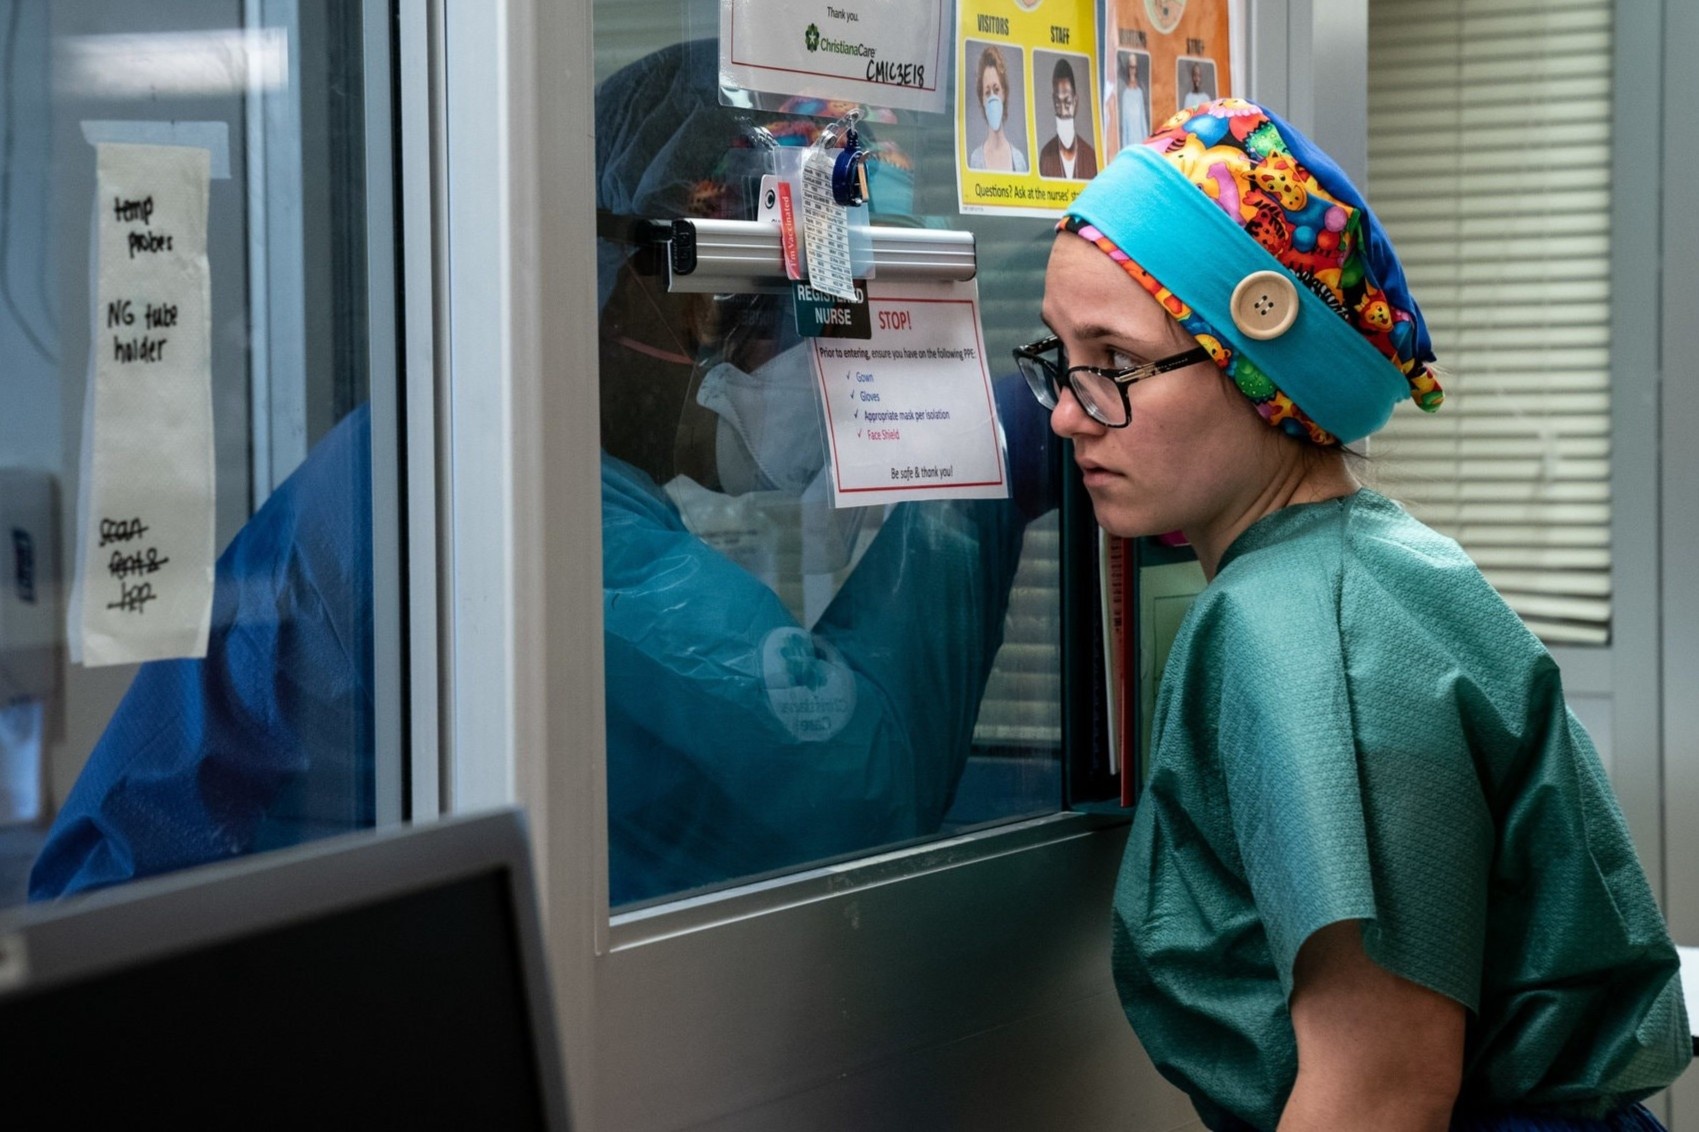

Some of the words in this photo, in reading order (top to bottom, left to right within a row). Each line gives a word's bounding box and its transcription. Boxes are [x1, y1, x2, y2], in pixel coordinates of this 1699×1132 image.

[827, 6, 845, 19] Thank
[847, 11, 859, 22] you.
[977, 13, 1009, 36] VISITORS
[1050, 25, 1070, 45] STAFF
[820, 38, 876, 58] ChristianaCare
[975, 183, 1012, 198] Questions?
[1014, 186, 1026, 199] Ask
[1027, 188, 1034, 199] at
[1035, 188, 1046, 200] the
[113, 196, 154, 225] temp
[781, 196, 795, 249] Vaccinated
[797, 284, 864, 304] REGISD
[107, 300, 135, 329] NG
[144, 302, 178, 330] tube
[814, 307, 852, 325] NURSE
[878, 311, 912, 330] STOP!
[114, 335, 167, 363] holder
[819, 347, 835, 359] Prior
[836, 348, 843, 358] to
[844, 347, 870, 361] entering,
[872, 349, 891, 359] ensure
[893, 349, 903, 361] you
[903, 347, 917, 359] have
[918, 350, 927, 359] on
[927, 347, 937, 359] the
[937, 347, 964, 361] following
[856, 371, 874, 383] Gown
[860, 390, 880, 402] Gloves
[864, 410, 899, 423] Appropriate
[899, 409, 914, 420] mask
[915, 411, 925, 422] per
[926, 409, 950, 420] isolation
[867, 429, 881, 441] Face
[881, 428, 900, 440] Shield
[891, 467, 900, 480] Be
[900, 466, 914, 481] safe
[921, 465, 938, 478] thank
[939, 465, 953, 480] you!
